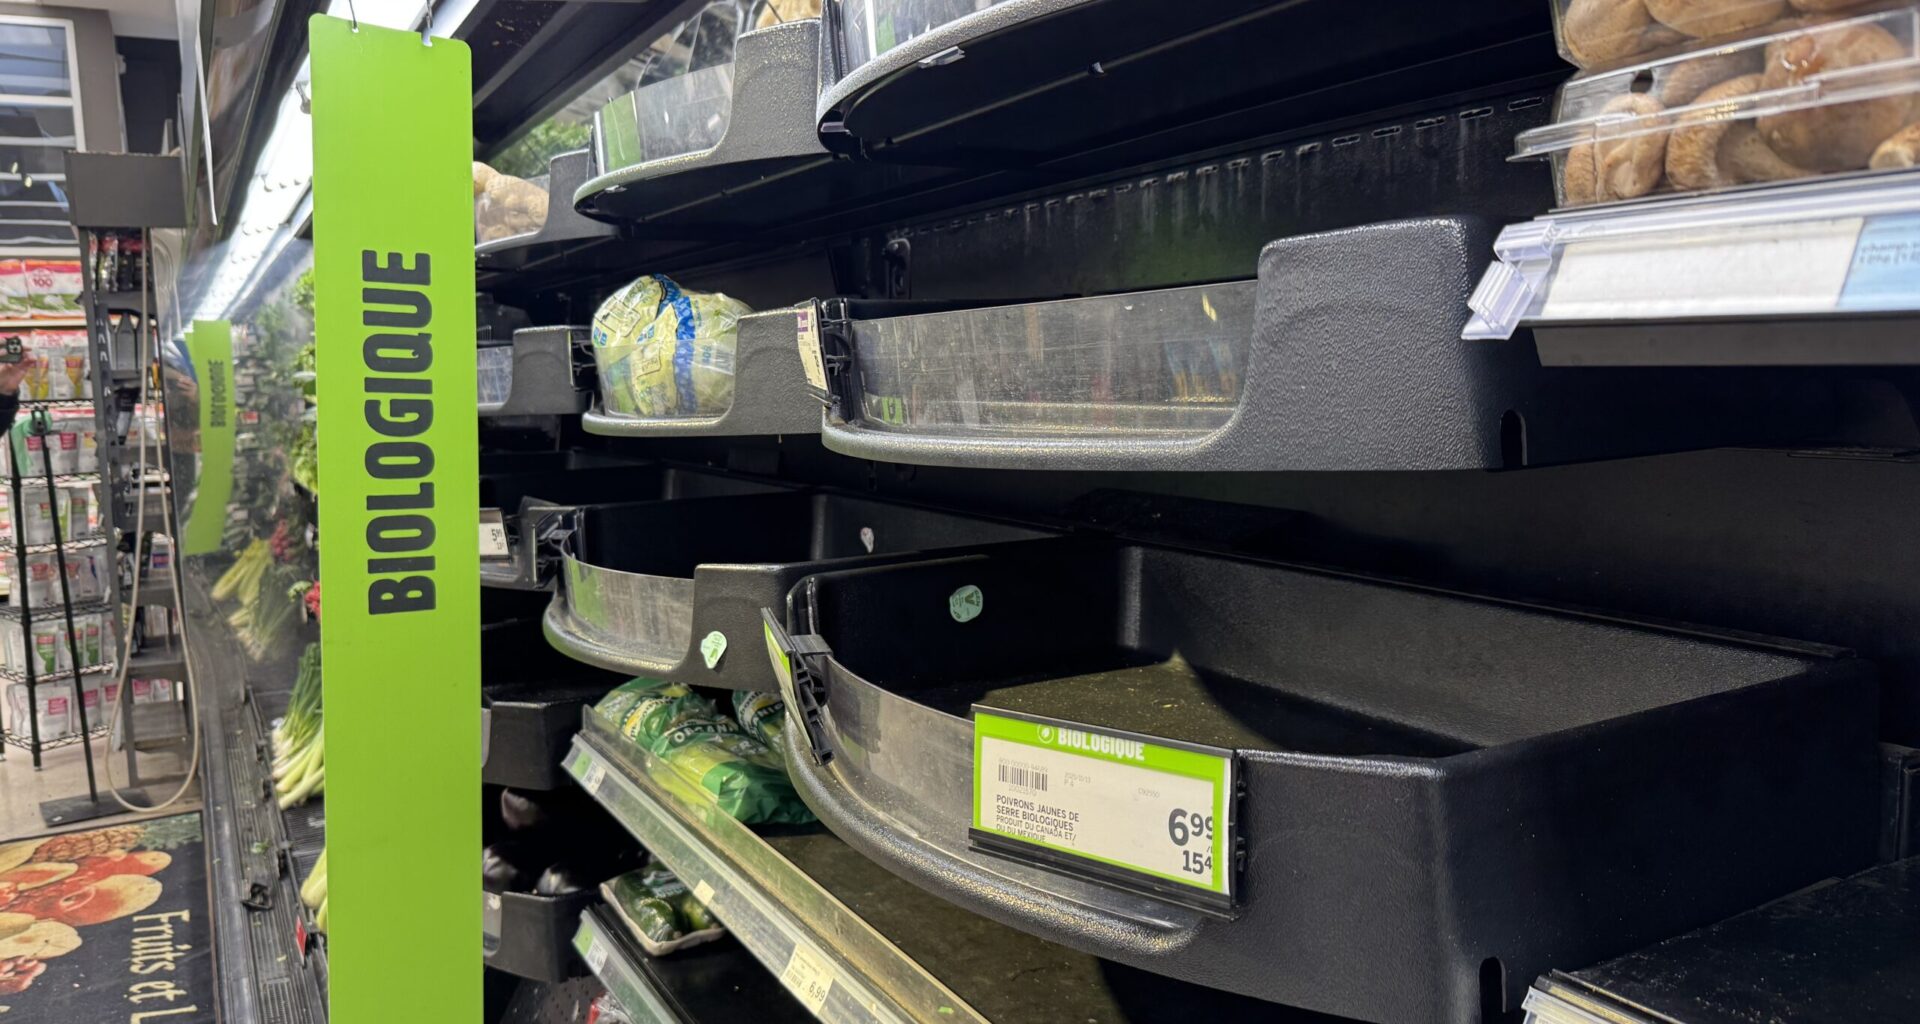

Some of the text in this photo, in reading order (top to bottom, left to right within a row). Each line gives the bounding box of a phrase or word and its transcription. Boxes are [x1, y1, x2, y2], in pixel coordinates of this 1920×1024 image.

[362, 250, 436, 614] BIOLOGIQUE
[1057, 727, 1145, 761] BIOLOGIQUE
[996, 805, 1074, 832] SERRE BIOLOGIQUES
[997, 795, 1080, 822] POIVRONS JAUNES DE
[996, 815, 1077, 842] PRODUIT DU CANADA ET/
[130, 909, 192, 975] Fruits
[129, 980, 188, 1004] et
[809, 980, 826, 1002] 6,99
